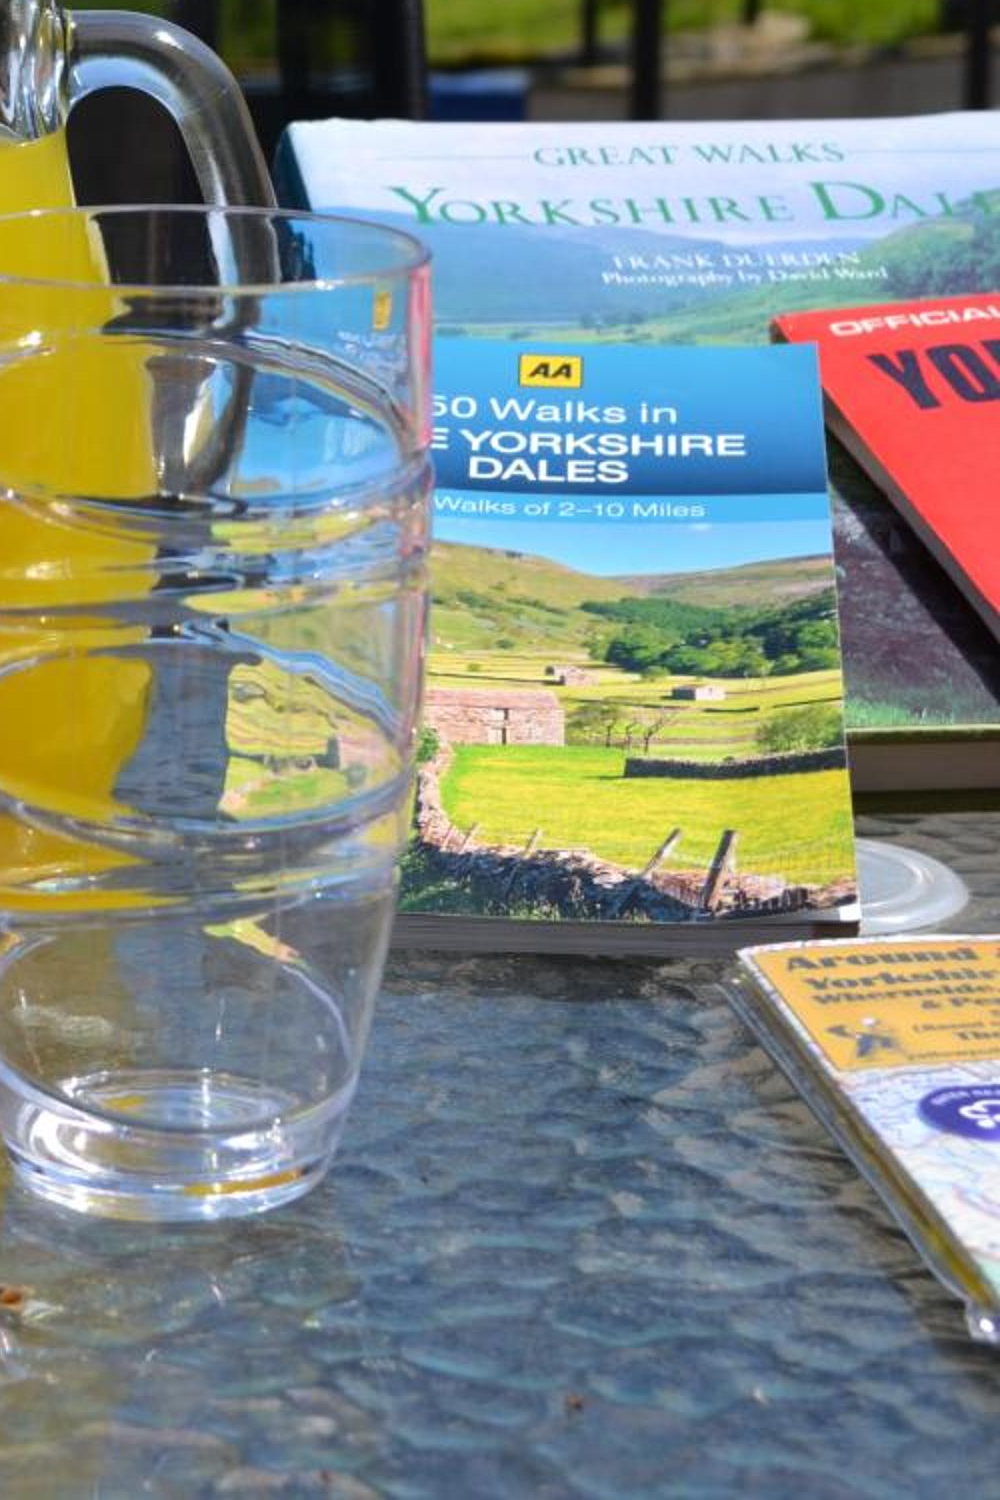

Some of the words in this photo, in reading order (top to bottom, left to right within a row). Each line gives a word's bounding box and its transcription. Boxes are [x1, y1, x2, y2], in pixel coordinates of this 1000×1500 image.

[533, 145, 678, 166] GREAT
[691, 142, 845, 164] WALKS
[387, 185, 796, 226] YORKSHIRE
[528, 363, 573, 379] AA
[489, 398, 627, 425] Walks
[640, 402, 678, 425] in
[460, 429, 747, 457] YORKSHIRE
[469, 456, 629, 484] DALES
[433, 496, 517, 516] Walks
[523, 499, 549, 516] of
[632, 503, 706, 518] Miles
[786, 947, 980, 973] Around
